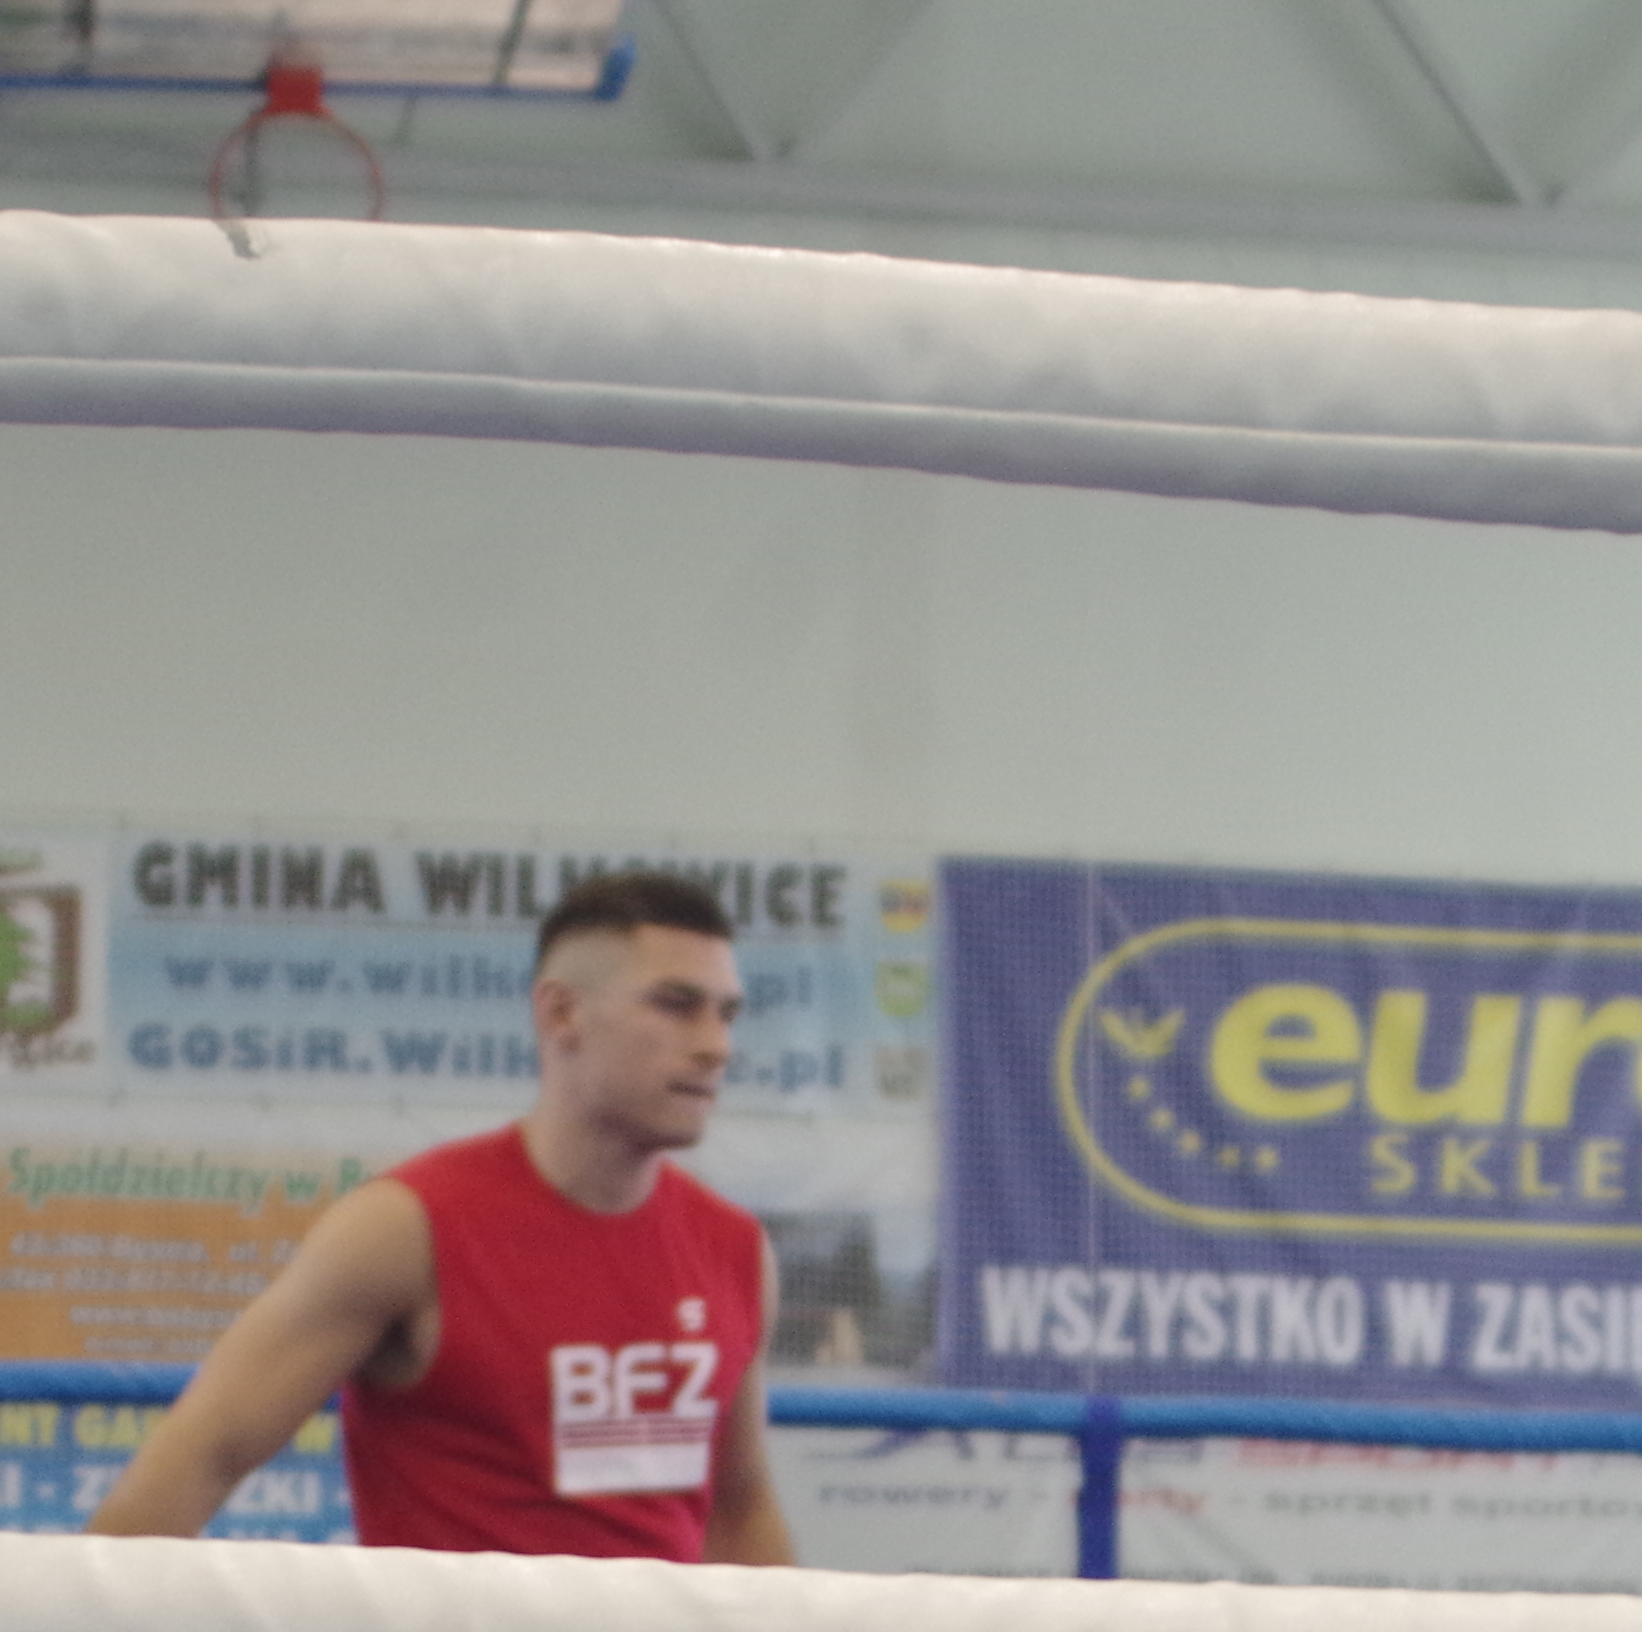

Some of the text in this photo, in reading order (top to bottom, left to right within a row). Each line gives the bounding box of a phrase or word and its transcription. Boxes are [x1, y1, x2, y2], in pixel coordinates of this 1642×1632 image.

[133, 843, 387, 914] GMINA
[980, 1264, 1360, 1368] WSZYSTKO
[1384, 1284, 1451, 1368] W
